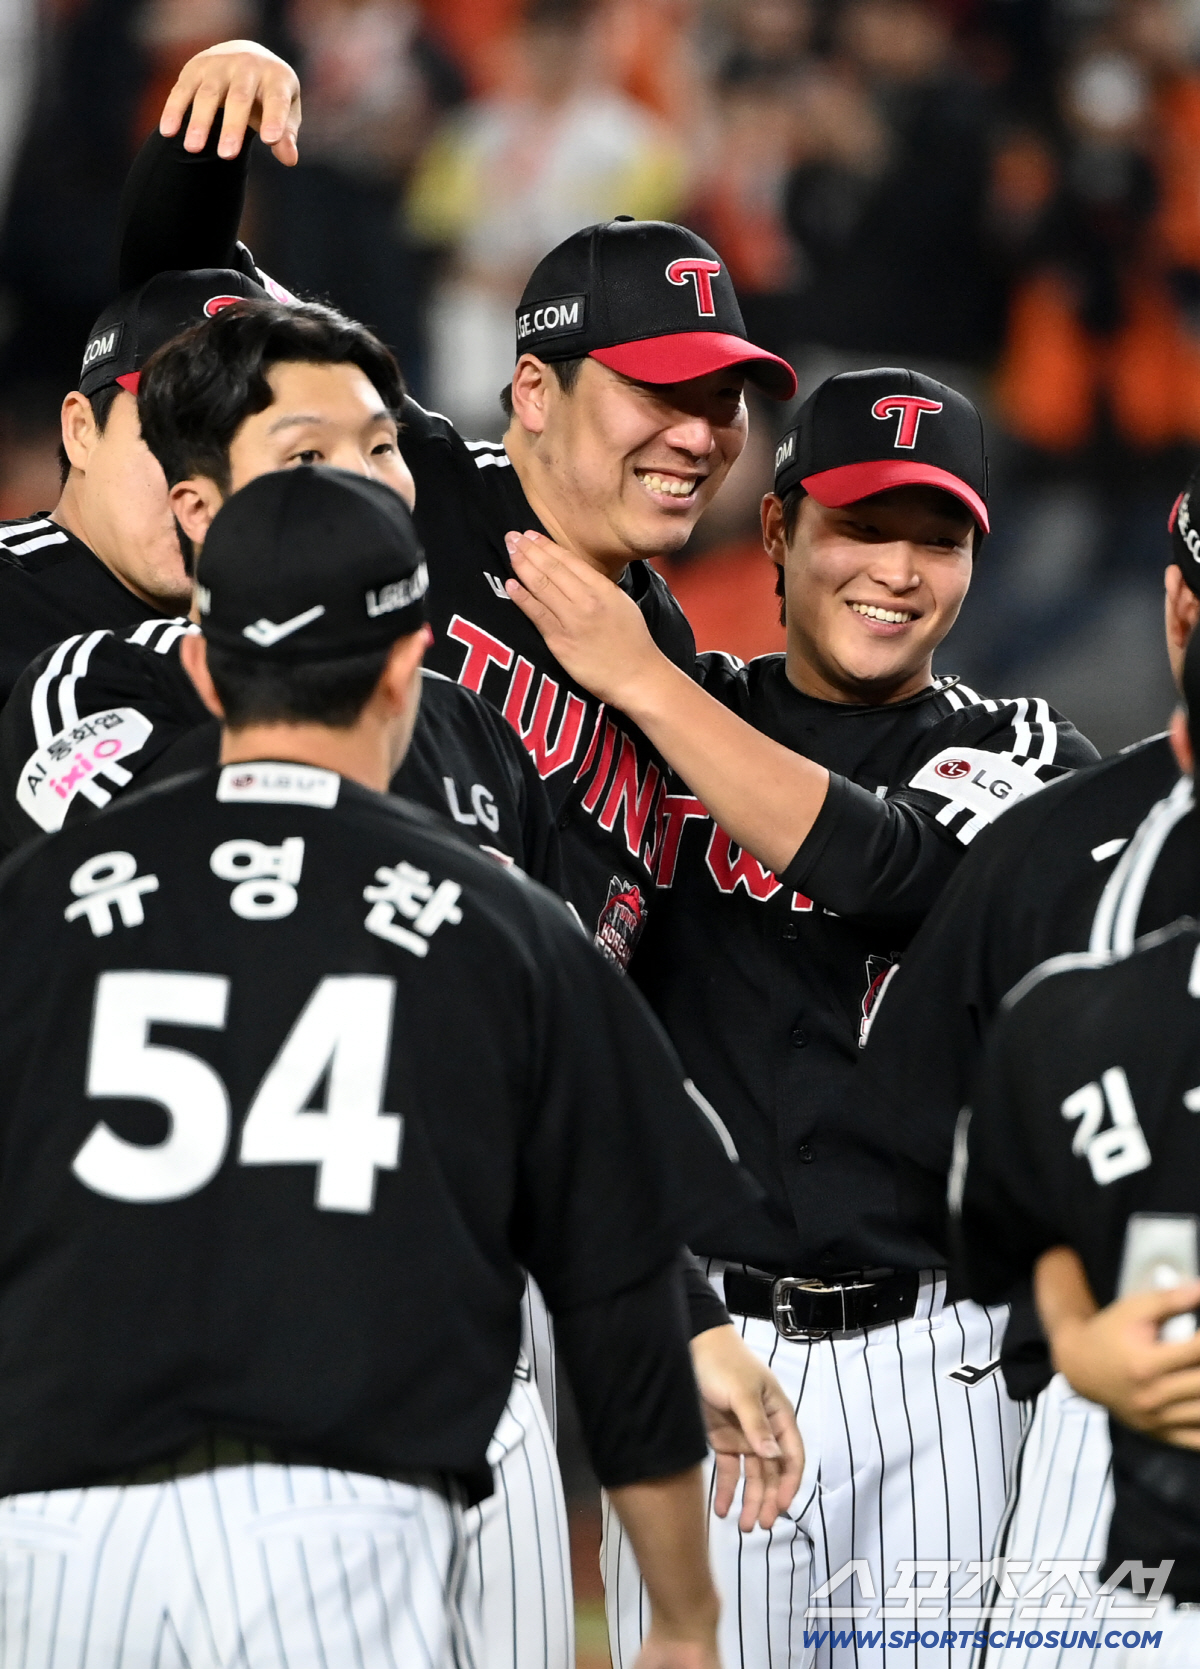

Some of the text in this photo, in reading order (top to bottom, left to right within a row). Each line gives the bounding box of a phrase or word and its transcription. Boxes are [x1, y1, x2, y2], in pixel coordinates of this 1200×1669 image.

[665, 257, 722, 317] T
[871, 394, 943, 449] T
[442, 776, 499, 833] LG
[971, 769, 1013, 800] LG
[71, 969, 403, 1214] 54
[1061, 1066, 1152, 1185] 김
